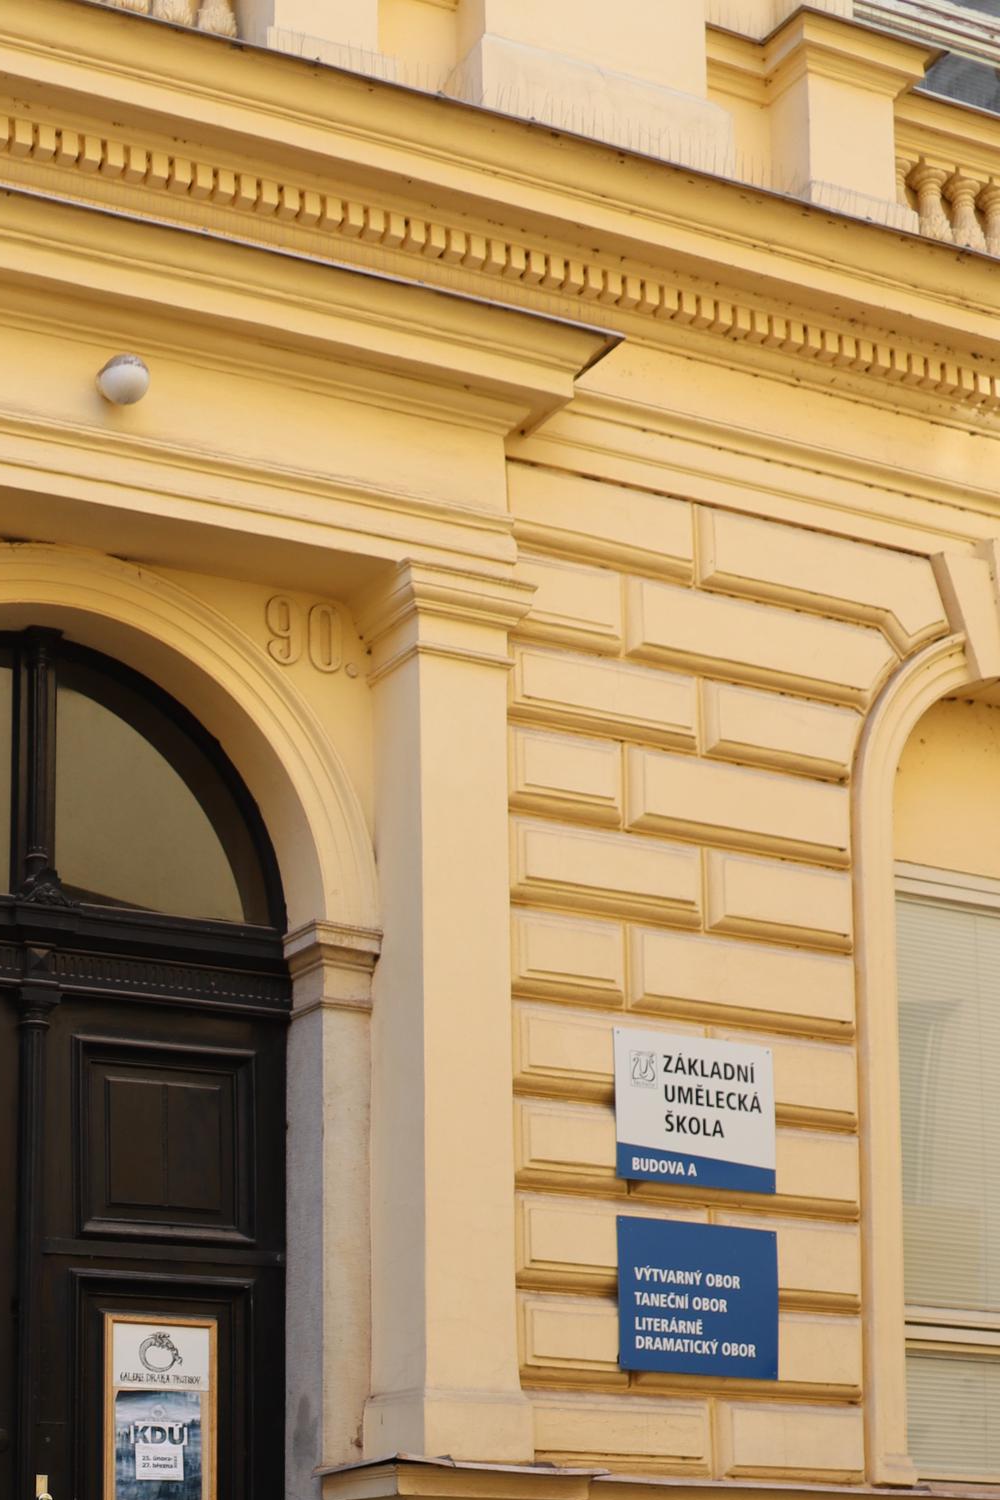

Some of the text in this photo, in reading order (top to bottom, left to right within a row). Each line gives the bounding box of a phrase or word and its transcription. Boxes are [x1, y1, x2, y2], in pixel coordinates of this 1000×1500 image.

[663, 1053, 755, 1084] ZÁKLADNÍ
[664, 1084, 762, 1114] UMĚLECKÁ
[665, 1110, 724, 1138] ŠKOLA
[632, 1157, 697, 1177] BUDOVA A
[634, 1265, 741, 1289] VÝTVARNÝ OBOR
[634, 1292, 728, 1313] TANEČNÍ OBOR
[635, 1316, 703, 1335] LITERÁRNĚ
[635, 1335, 756, 1358] DRAMATICKÝ OBOR
